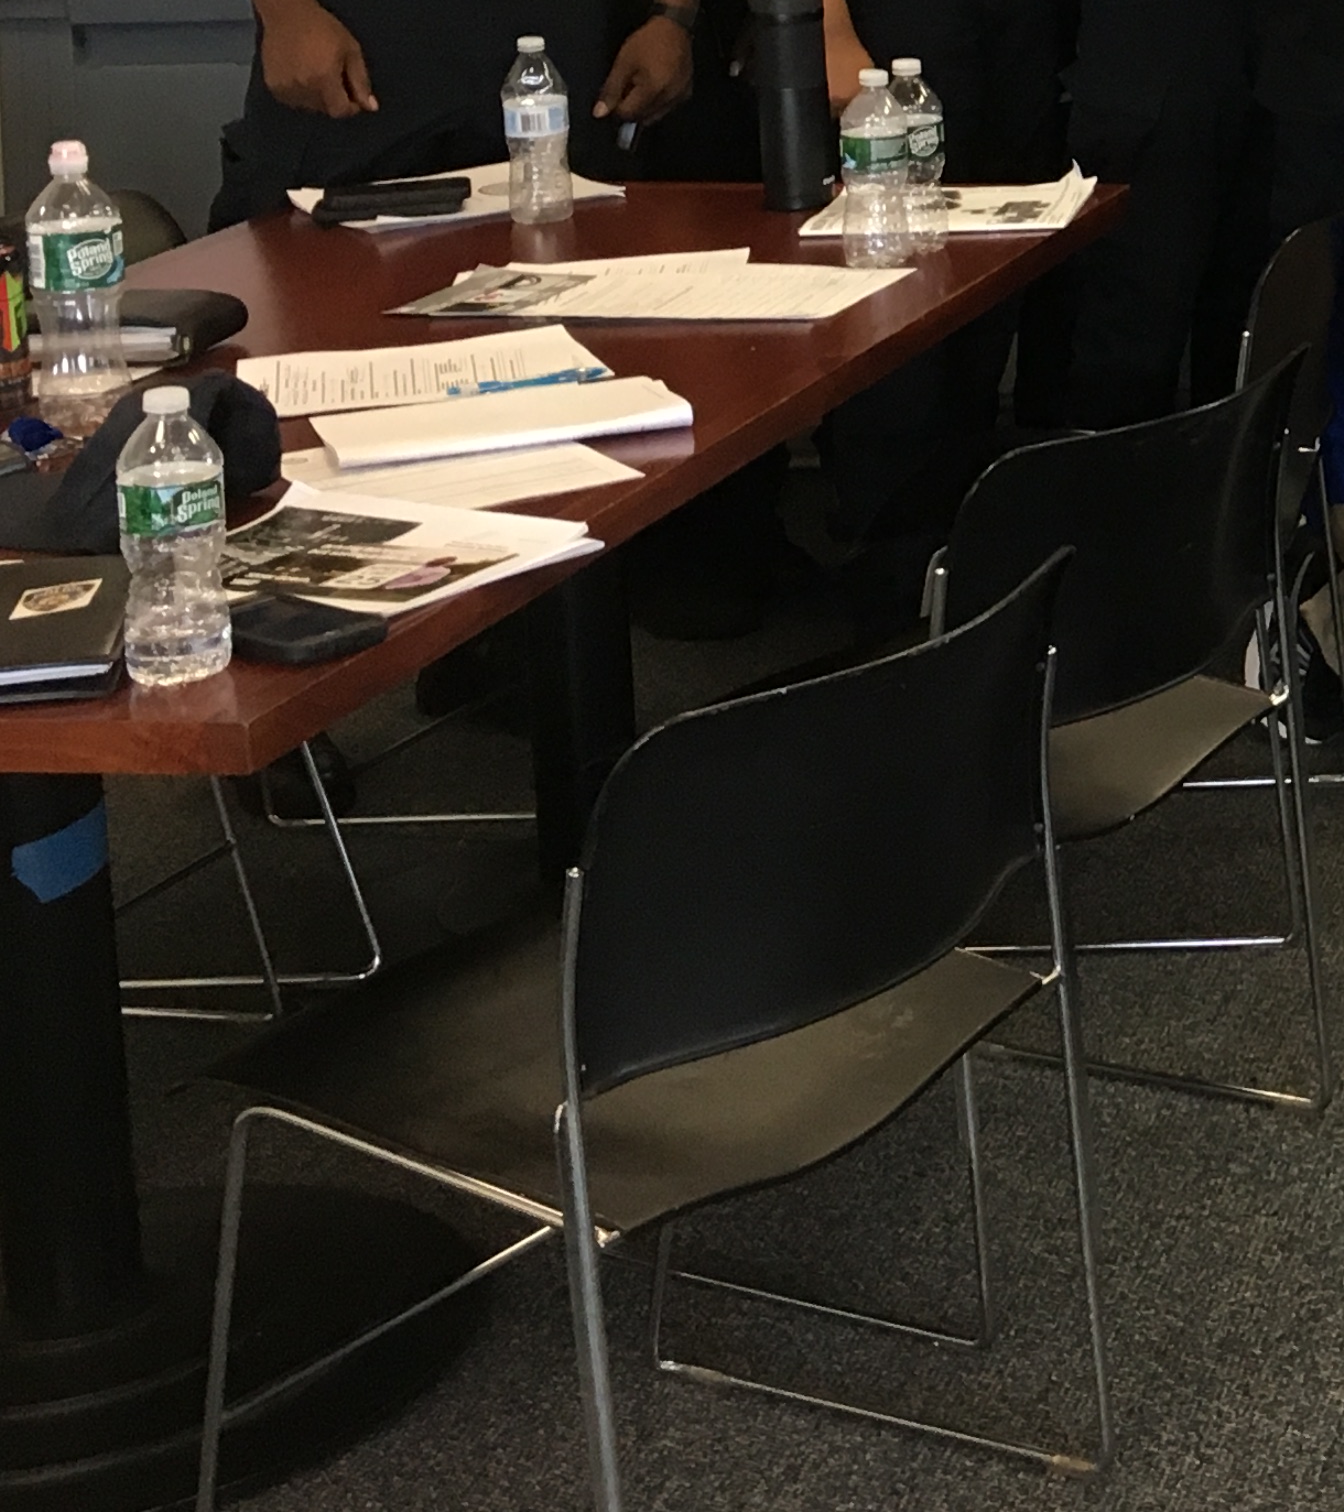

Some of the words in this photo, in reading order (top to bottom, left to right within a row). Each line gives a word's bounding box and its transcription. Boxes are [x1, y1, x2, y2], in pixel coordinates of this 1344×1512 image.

[67, 238, 110, 262] Poland
[70, 252, 113, 276] Spring
[182, 484, 218, 504] Poland
